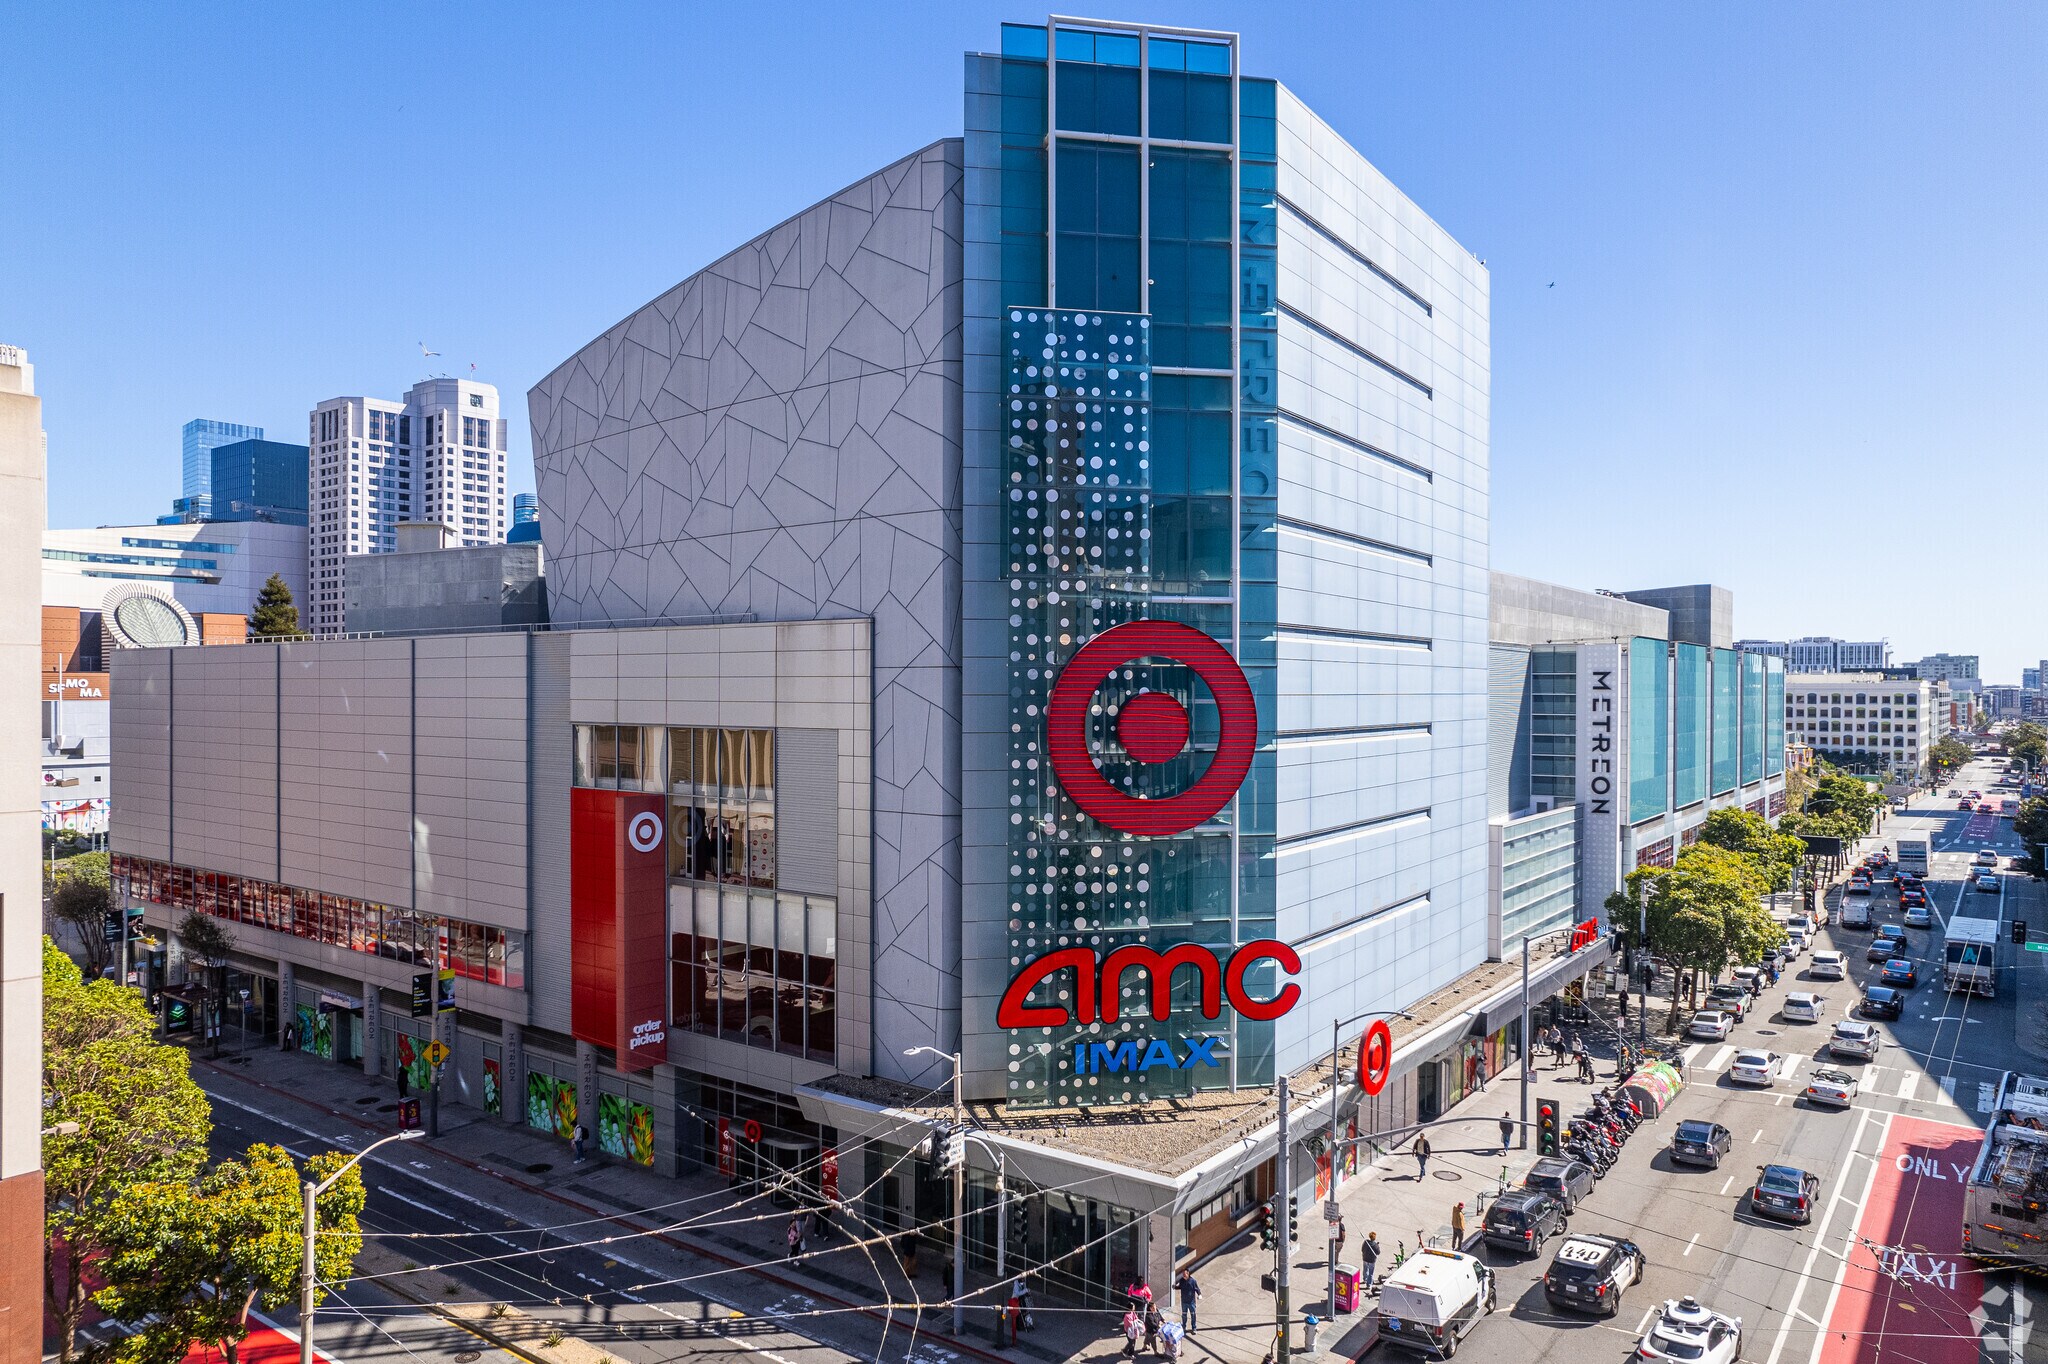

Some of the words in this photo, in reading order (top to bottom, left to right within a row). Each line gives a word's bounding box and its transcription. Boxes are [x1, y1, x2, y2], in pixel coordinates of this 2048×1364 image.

[66, 679, 89, 688] MO
[80, 688, 102, 697] MA
[1591, 671, 1611, 814] METREON
[633, 1020, 662, 1034] order
[630, 1032, 665, 1050] pickup
[1896, 1154, 1970, 1183] ONLY
[1879, 1249, 1957, 1290] TAXI
